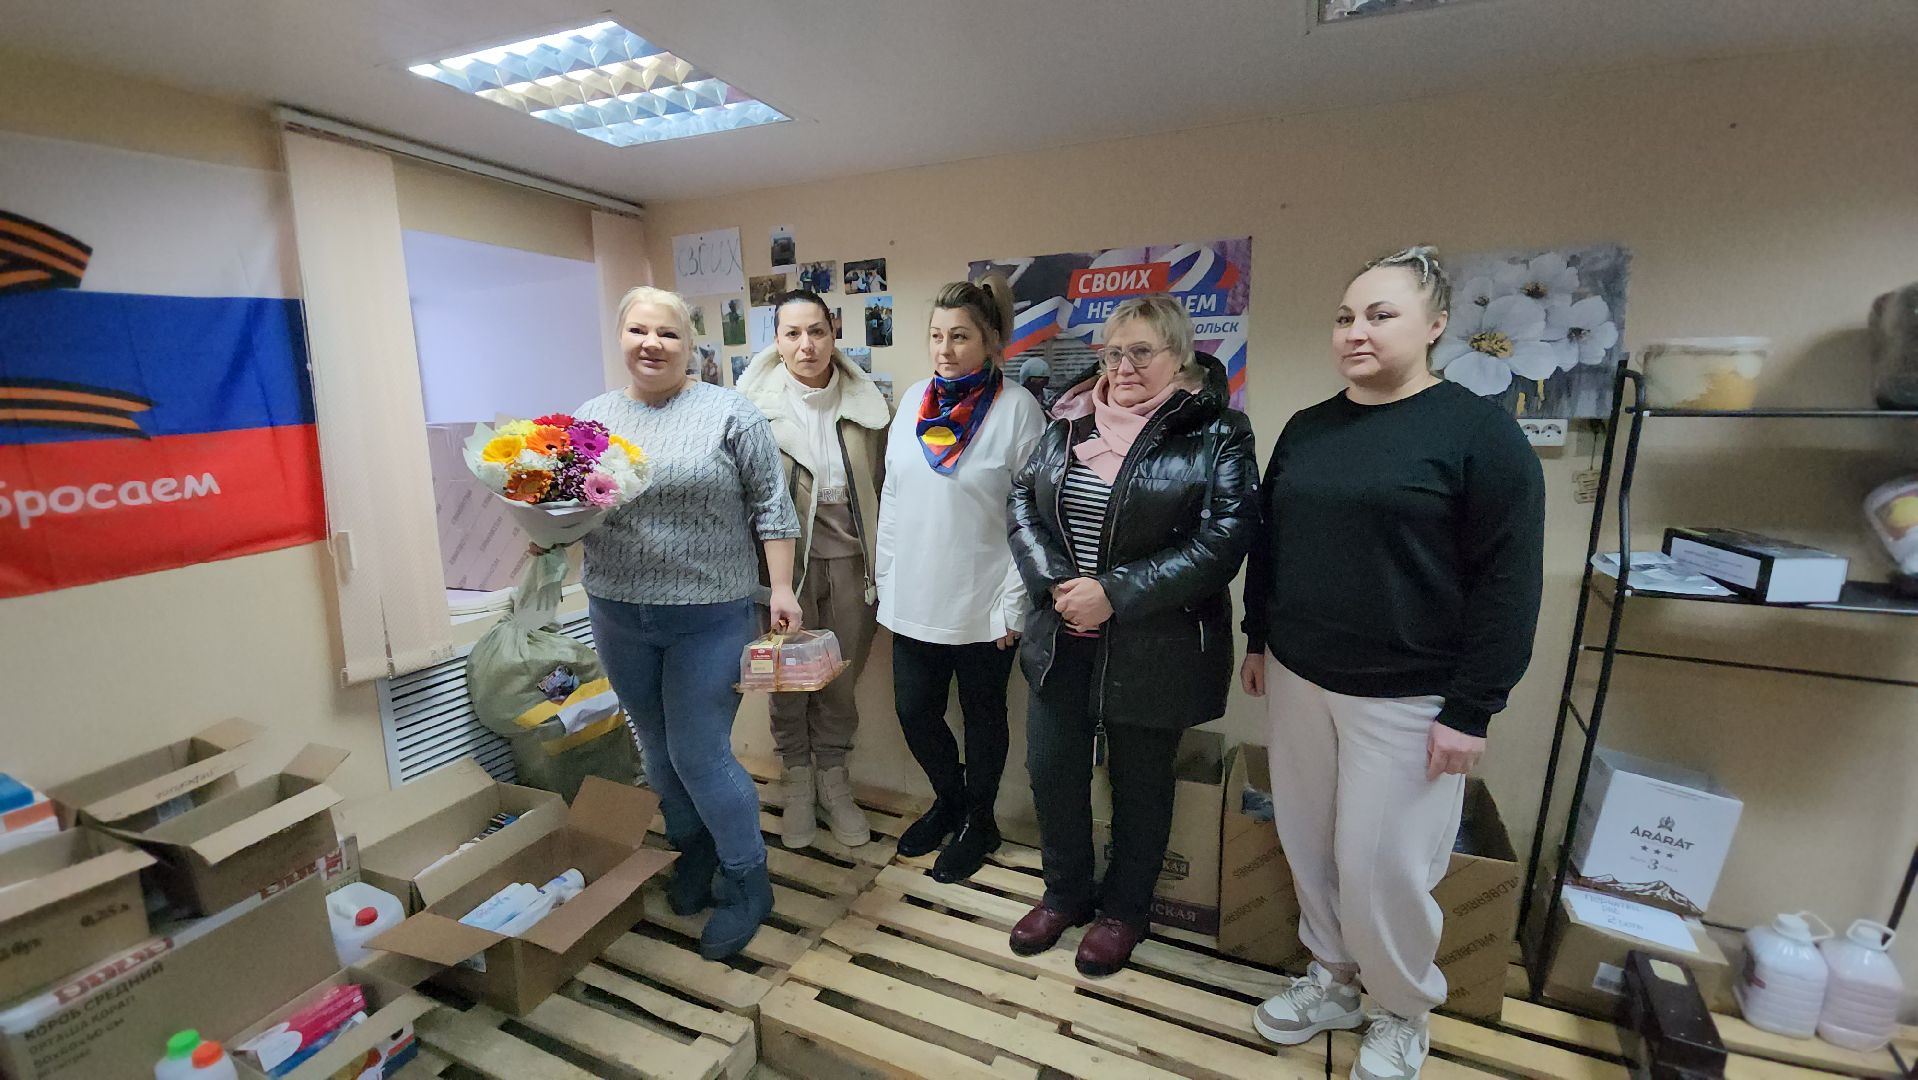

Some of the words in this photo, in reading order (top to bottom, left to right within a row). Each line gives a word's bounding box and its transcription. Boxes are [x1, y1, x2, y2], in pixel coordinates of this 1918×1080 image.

[1078, 268, 1153, 294] СВОИХ
[1087, 300, 1114, 319] НЕ
[1195, 321, 1239, 335] ОЛЬСК
[1629, 825, 1695, 851] ARARAT
[1163, 860, 1187, 875] КАЯ
[1647, 857, 1660, 871] 3
[23, 1008, 82, 1041] КОРОБ
[84, 961, 164, 1011] СРЕДНИЙ
